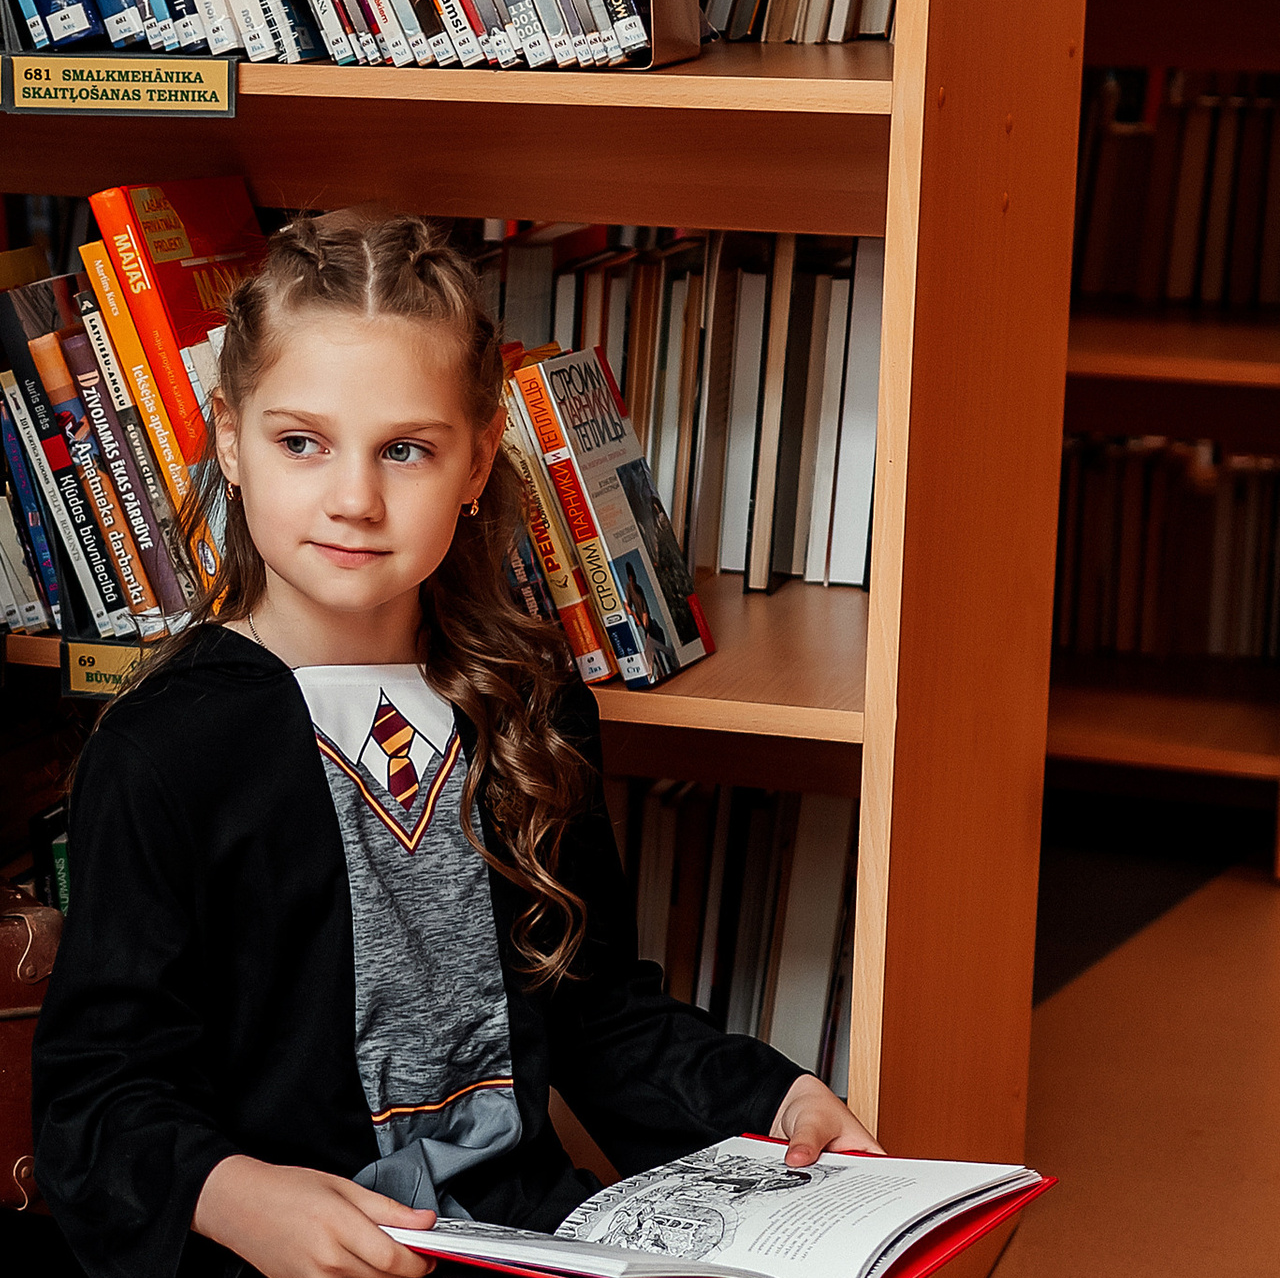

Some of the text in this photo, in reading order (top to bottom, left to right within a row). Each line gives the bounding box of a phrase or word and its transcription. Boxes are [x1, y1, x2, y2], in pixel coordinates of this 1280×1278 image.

[22, 84, 220, 104] SKAITĻOŠANAS TEHNIKA
[23, 66, 204, 84] 681 SMALKMEHĀNIKA
[23, 377, 41, 404] Juris
[521, 375, 560, 452] ТЕПЛИЦЫ
[19, 416, 31, 430] 101
[73, 438, 119, 528] Amatnieka
[75, 368, 157, 551] DZĪVOJAMĀS ĒKAS PĀRBŪVE
[55, 473, 90, 525] Kļūdas
[552, 459, 592, 540] ПАРНИКИ
[581, 541, 618, 613] СТРОИМ
[78, 656, 96, 667] 69
